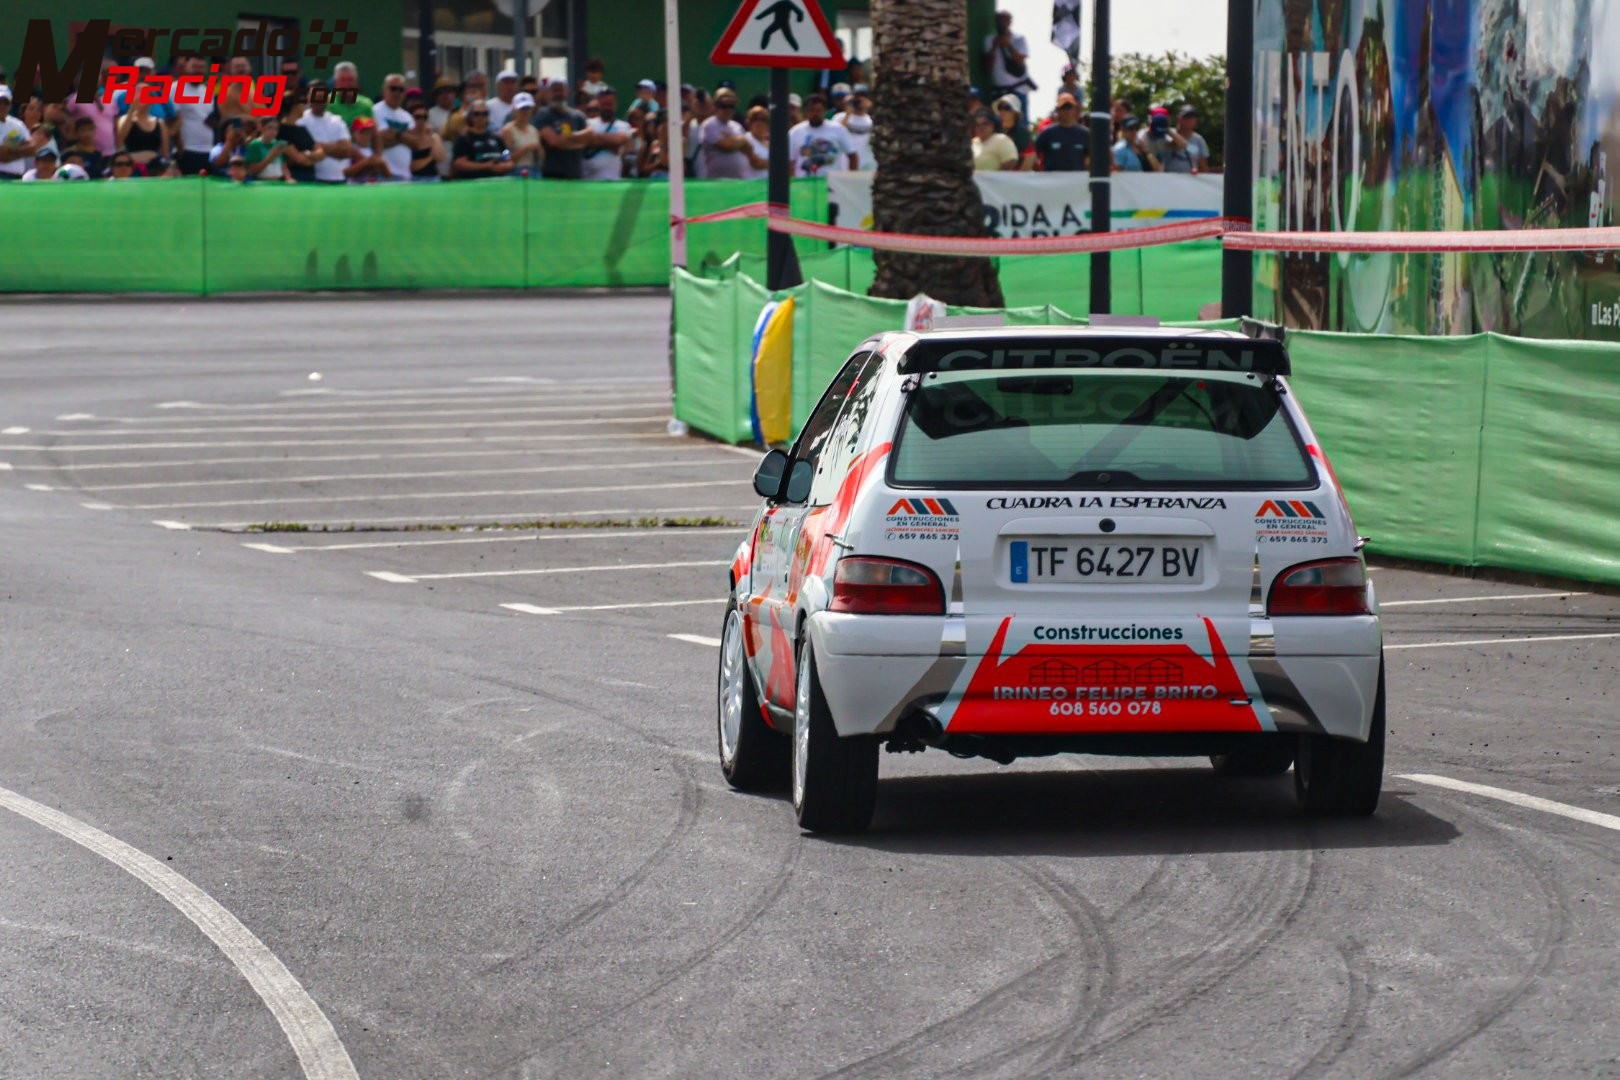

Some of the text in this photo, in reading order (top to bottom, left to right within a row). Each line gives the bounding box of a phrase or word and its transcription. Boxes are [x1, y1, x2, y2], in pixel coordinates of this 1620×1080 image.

[1061, 203, 1082, 227] A
[1598, 301, 1612, 326] Las
[938, 342, 1254, 371] CITROËN
[986, 496, 1227, 510] CUADRA LA ESPERANZA
[1254, 518, 1328, 526] CONSTRUCCIONES
[940, 533, 959, 541] 373
[1310, 536, 1329, 544] 373
[1015, 566, 1023, 575] E
[1031, 547, 1200, 578] TF 6427 BV
[1033, 623, 1184, 640] Construcciones
[993, 684, 1218, 701] IRINEO FELIPE BRITO
[1050, 701, 1162, 716] 608 560 078
